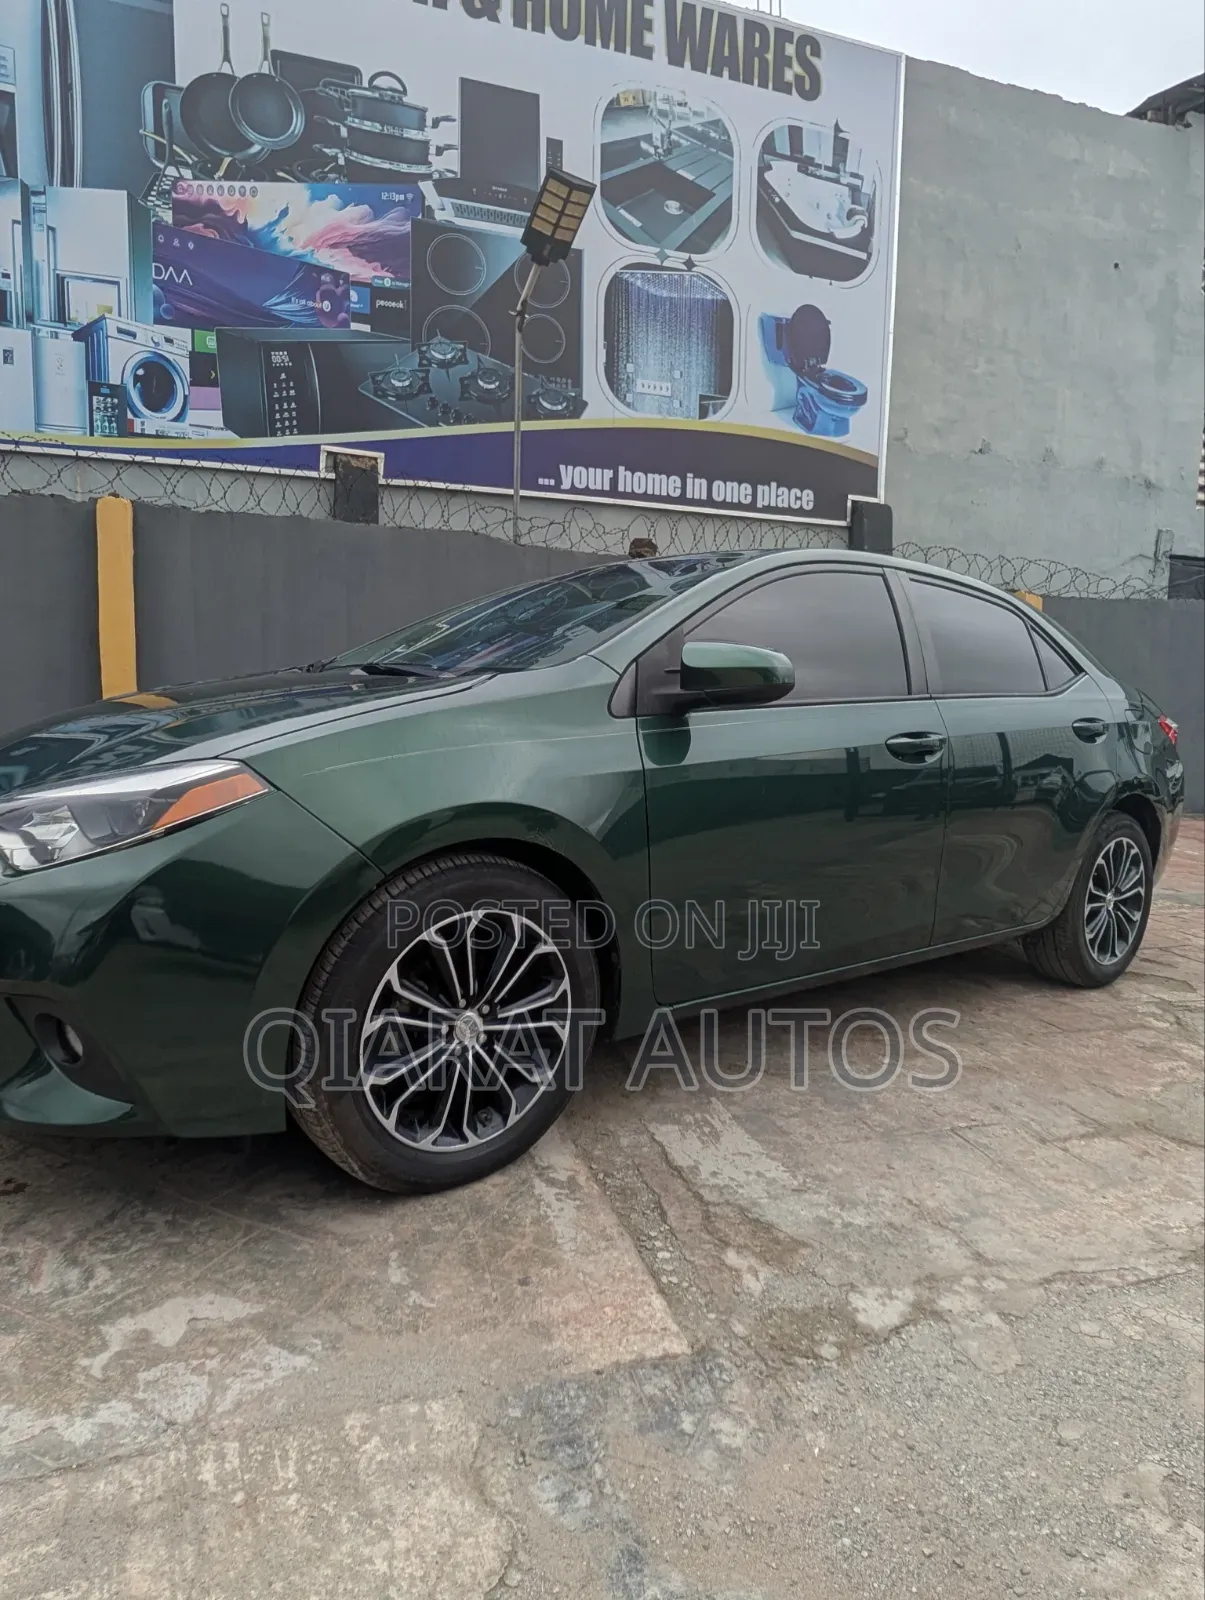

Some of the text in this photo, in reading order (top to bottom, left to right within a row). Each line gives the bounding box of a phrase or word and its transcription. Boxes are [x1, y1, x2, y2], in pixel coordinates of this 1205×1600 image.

[664, 0, 822, 102] WARES
[559, 464, 613, 490] your
[617, 465, 681, 498] home
[686, 473, 708, 500] in
[712, 480, 752, 504] one
[756, 482, 814, 511] place
